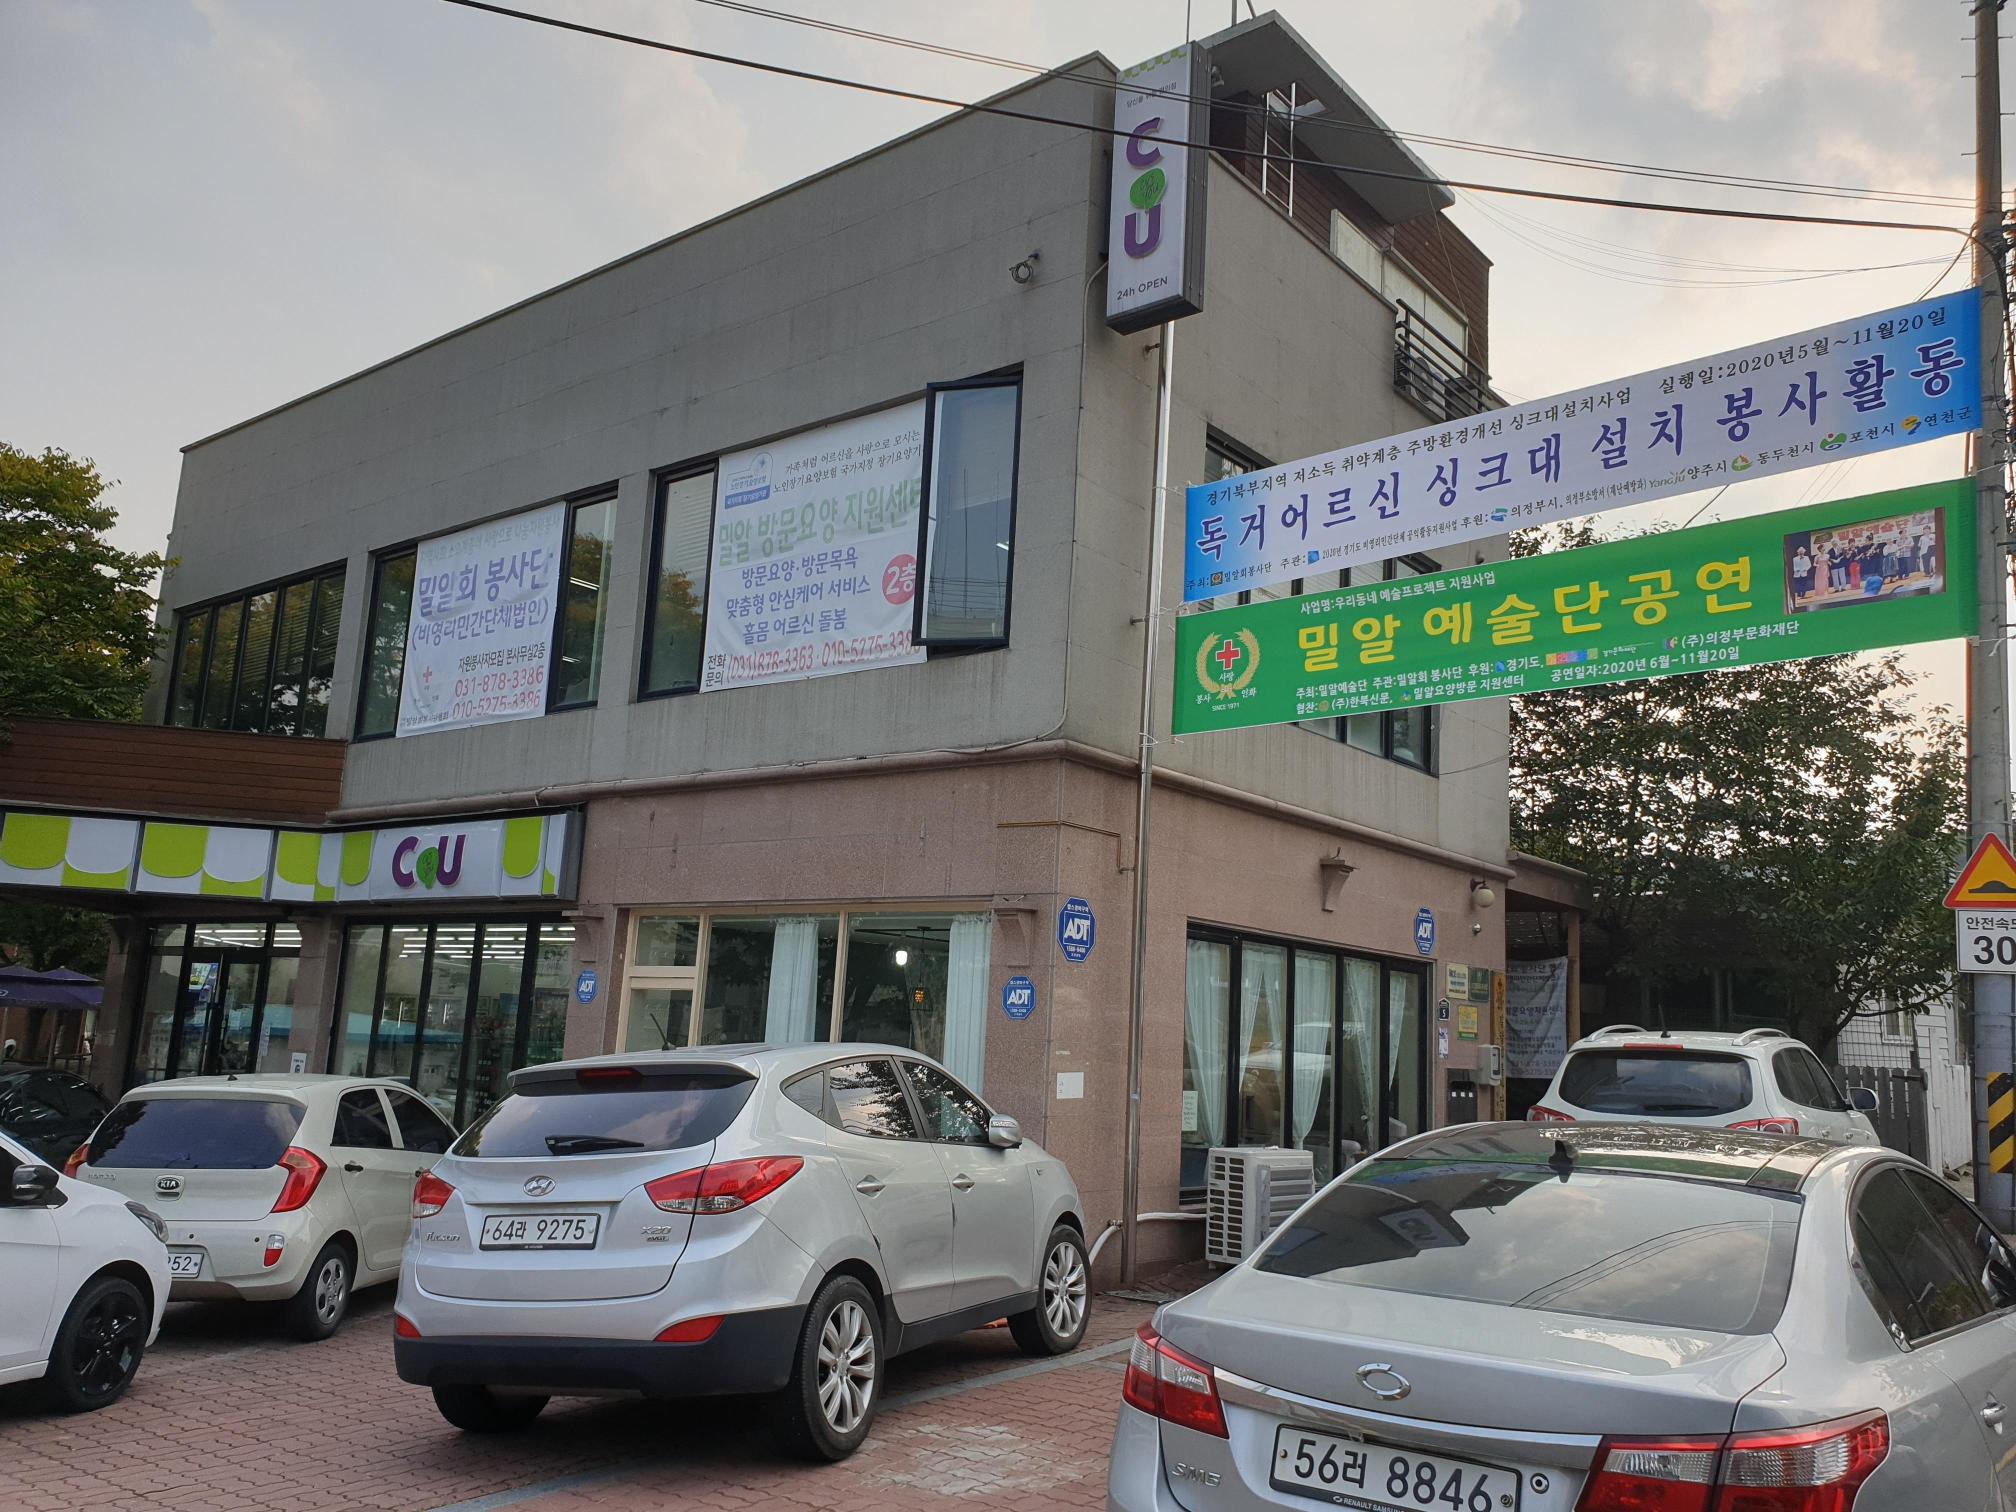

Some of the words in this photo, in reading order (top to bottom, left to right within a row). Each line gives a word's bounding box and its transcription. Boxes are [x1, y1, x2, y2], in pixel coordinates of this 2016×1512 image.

[1117, 287, 1135, 301] 24h
[1138, 276, 1168, 294] OPEN
[785, 455, 818, 474] 가족처럼
[856, 438, 891, 456] 사랑으로
[894, 430, 922, 447] 모시는
[1196, 470, 1402, 562] 독거어르신
[1426, 431, 1563, 507] 싱크대
[1591, 402, 1685, 471] 설치
[1715, 336, 1967, 444] 봉사활동
[1206, 471, 1288, 507] 경기북부지역
[1294, 460, 1336, 486] 저소득
[1341, 444, 1403, 476] 취약계층
[1406, 418, 1504, 462] 주방환경개선
[1510, 385, 1633, 432] 싱크대설치사업
[1687, 459, 1727, 480] 양주시
[1756, 440, 1815, 466] 동두천시
[1849, 422, 1896, 445] 포천시
[1923, 405, 1973, 428] 연천군
[773, 465, 838, 494] 노인장기요양보험
[841, 457, 875, 475] 국가지정
[878, 444, 922, 469] 장기요양기
[758, 495, 839, 558] 방문요양
[1342, 542, 1362, 557] 경기도
[484, 548, 555, 603] 봉사단
[1379, 578, 1447, 603] 예술프로젝트
[1449, 570, 1495, 591] 지원사업
[726, 593, 765, 621] 맞춤형
[769, 582, 824, 611] 안심케어
[828, 574, 872, 598] 서비스
[773, 614, 815, 637] 어르신
[818, 607, 848, 631] 돌봄
[1298, 613, 1402, 673] 밀알
[707, 654, 728, 671] 전화
[1430, 665, 1463, 683] 봉사단
[705, 670, 724, 688] 문의
[1413, 680, 1478, 701] 밀알요양방문
[1480, 673, 1524, 690] 지원센터
[1211, 704, 1227, 712] SINCE
[391, 833, 467, 890] CU
[1064, 917, 1091, 941] ADT
[1417, 920, 1432, 938] ADT
[1973, 935, 2016, 966] 30
[578, 980, 595, 993] ADT
[1007, 989, 1031, 1005] ADT
[160, 1180, 176, 1188] KIA
[491, 1218, 528, 1242] 64라
[536, 1217, 587, 1242] 9275
[1171, 1461, 1223, 1488] SM5
[1294, 1438, 1367, 1489] 56러
[1386, 1455, 1493, 1512] 8846
[1343, 1497, 1372, 1510] RENAULT
